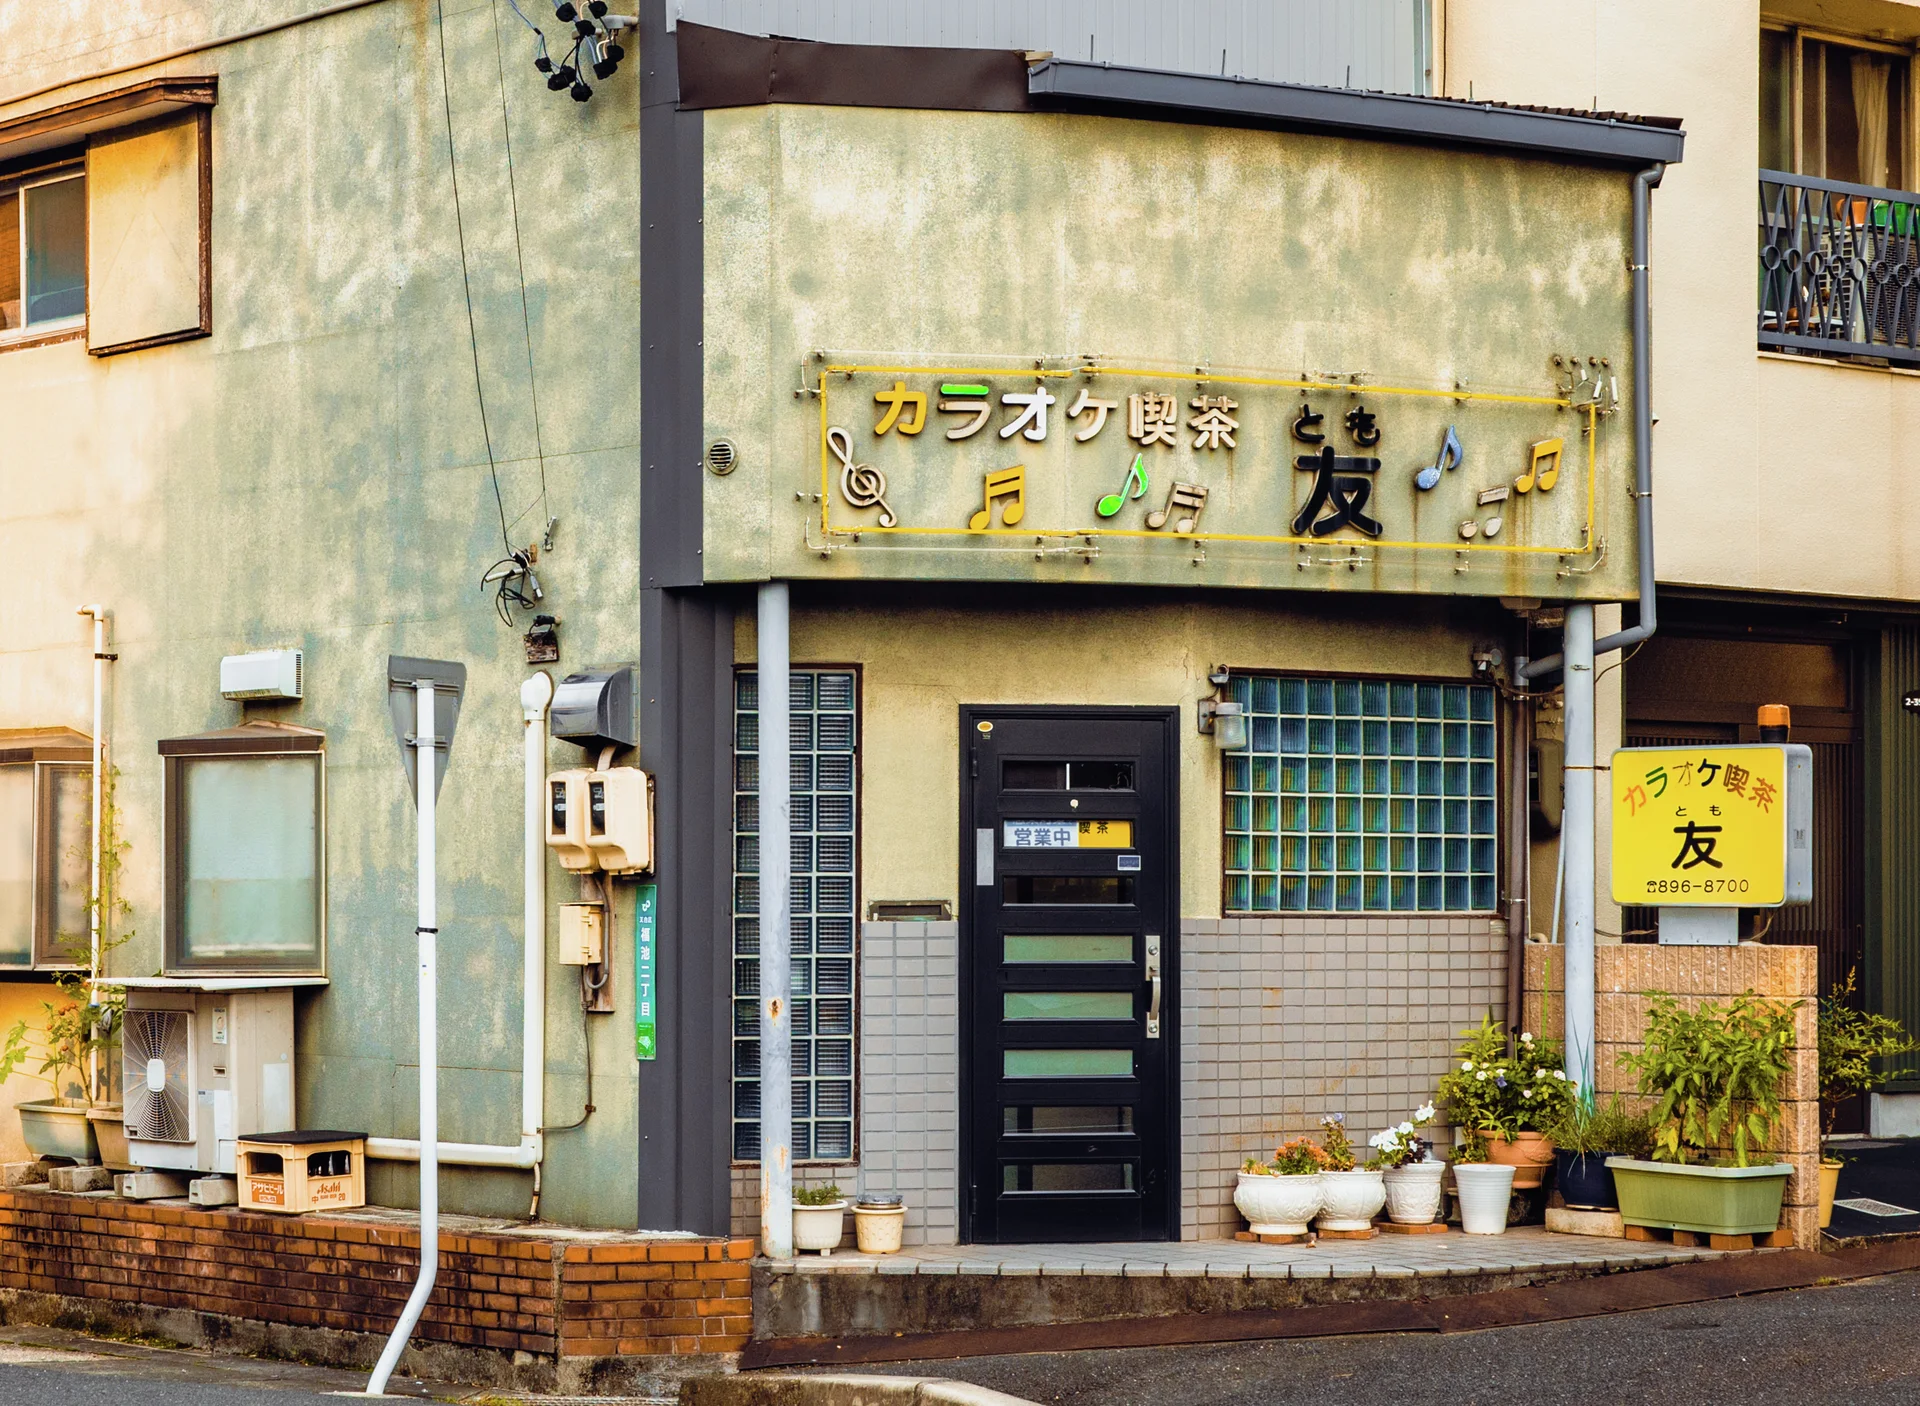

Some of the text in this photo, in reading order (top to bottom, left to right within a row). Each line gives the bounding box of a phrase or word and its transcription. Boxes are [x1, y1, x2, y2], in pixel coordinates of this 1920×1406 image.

[873, 380, 1239, 450] カラオケ喫茶
[1294, 403, 1381, 446] とも
[1291, 445, 1383, 536] 友
[1622, 758, 1778, 817] カラオケ喫茶
[1079, 821, 1108, 834] 喫茶
[1675, 805, 1722, 817] とも
[1014, 828, 1070, 846] 営業中
[1671, 820, 1723, 870] 友
[317, 1181, 341, 1194] Asahi
